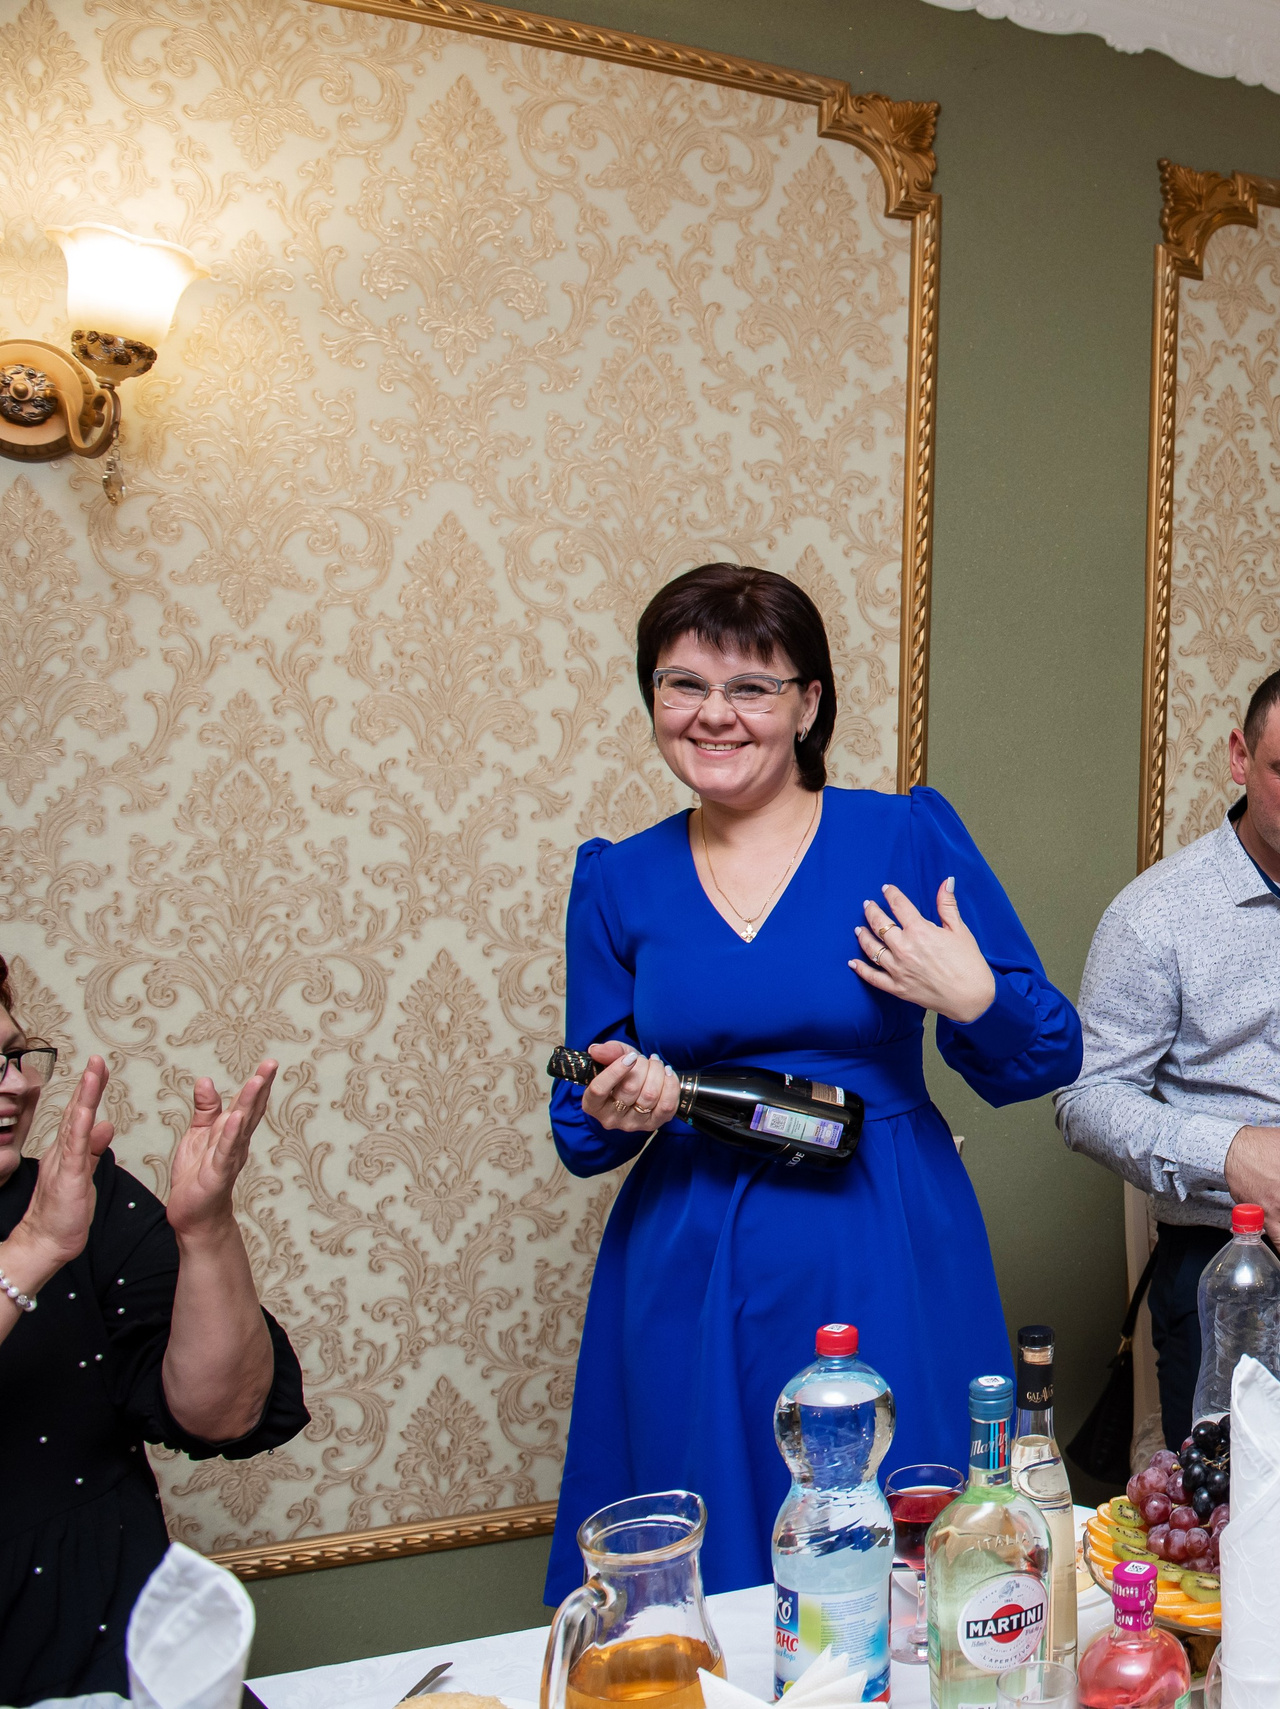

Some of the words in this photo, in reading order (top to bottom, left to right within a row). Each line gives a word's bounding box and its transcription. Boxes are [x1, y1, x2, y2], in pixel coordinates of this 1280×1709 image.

[785, 1151, 806, 1168] КОЕ
[970, 1431, 1010, 1458] Martin
[969, 1604, 1042, 1638] MARTINI
[776, 1631, 799, 1652] анс
